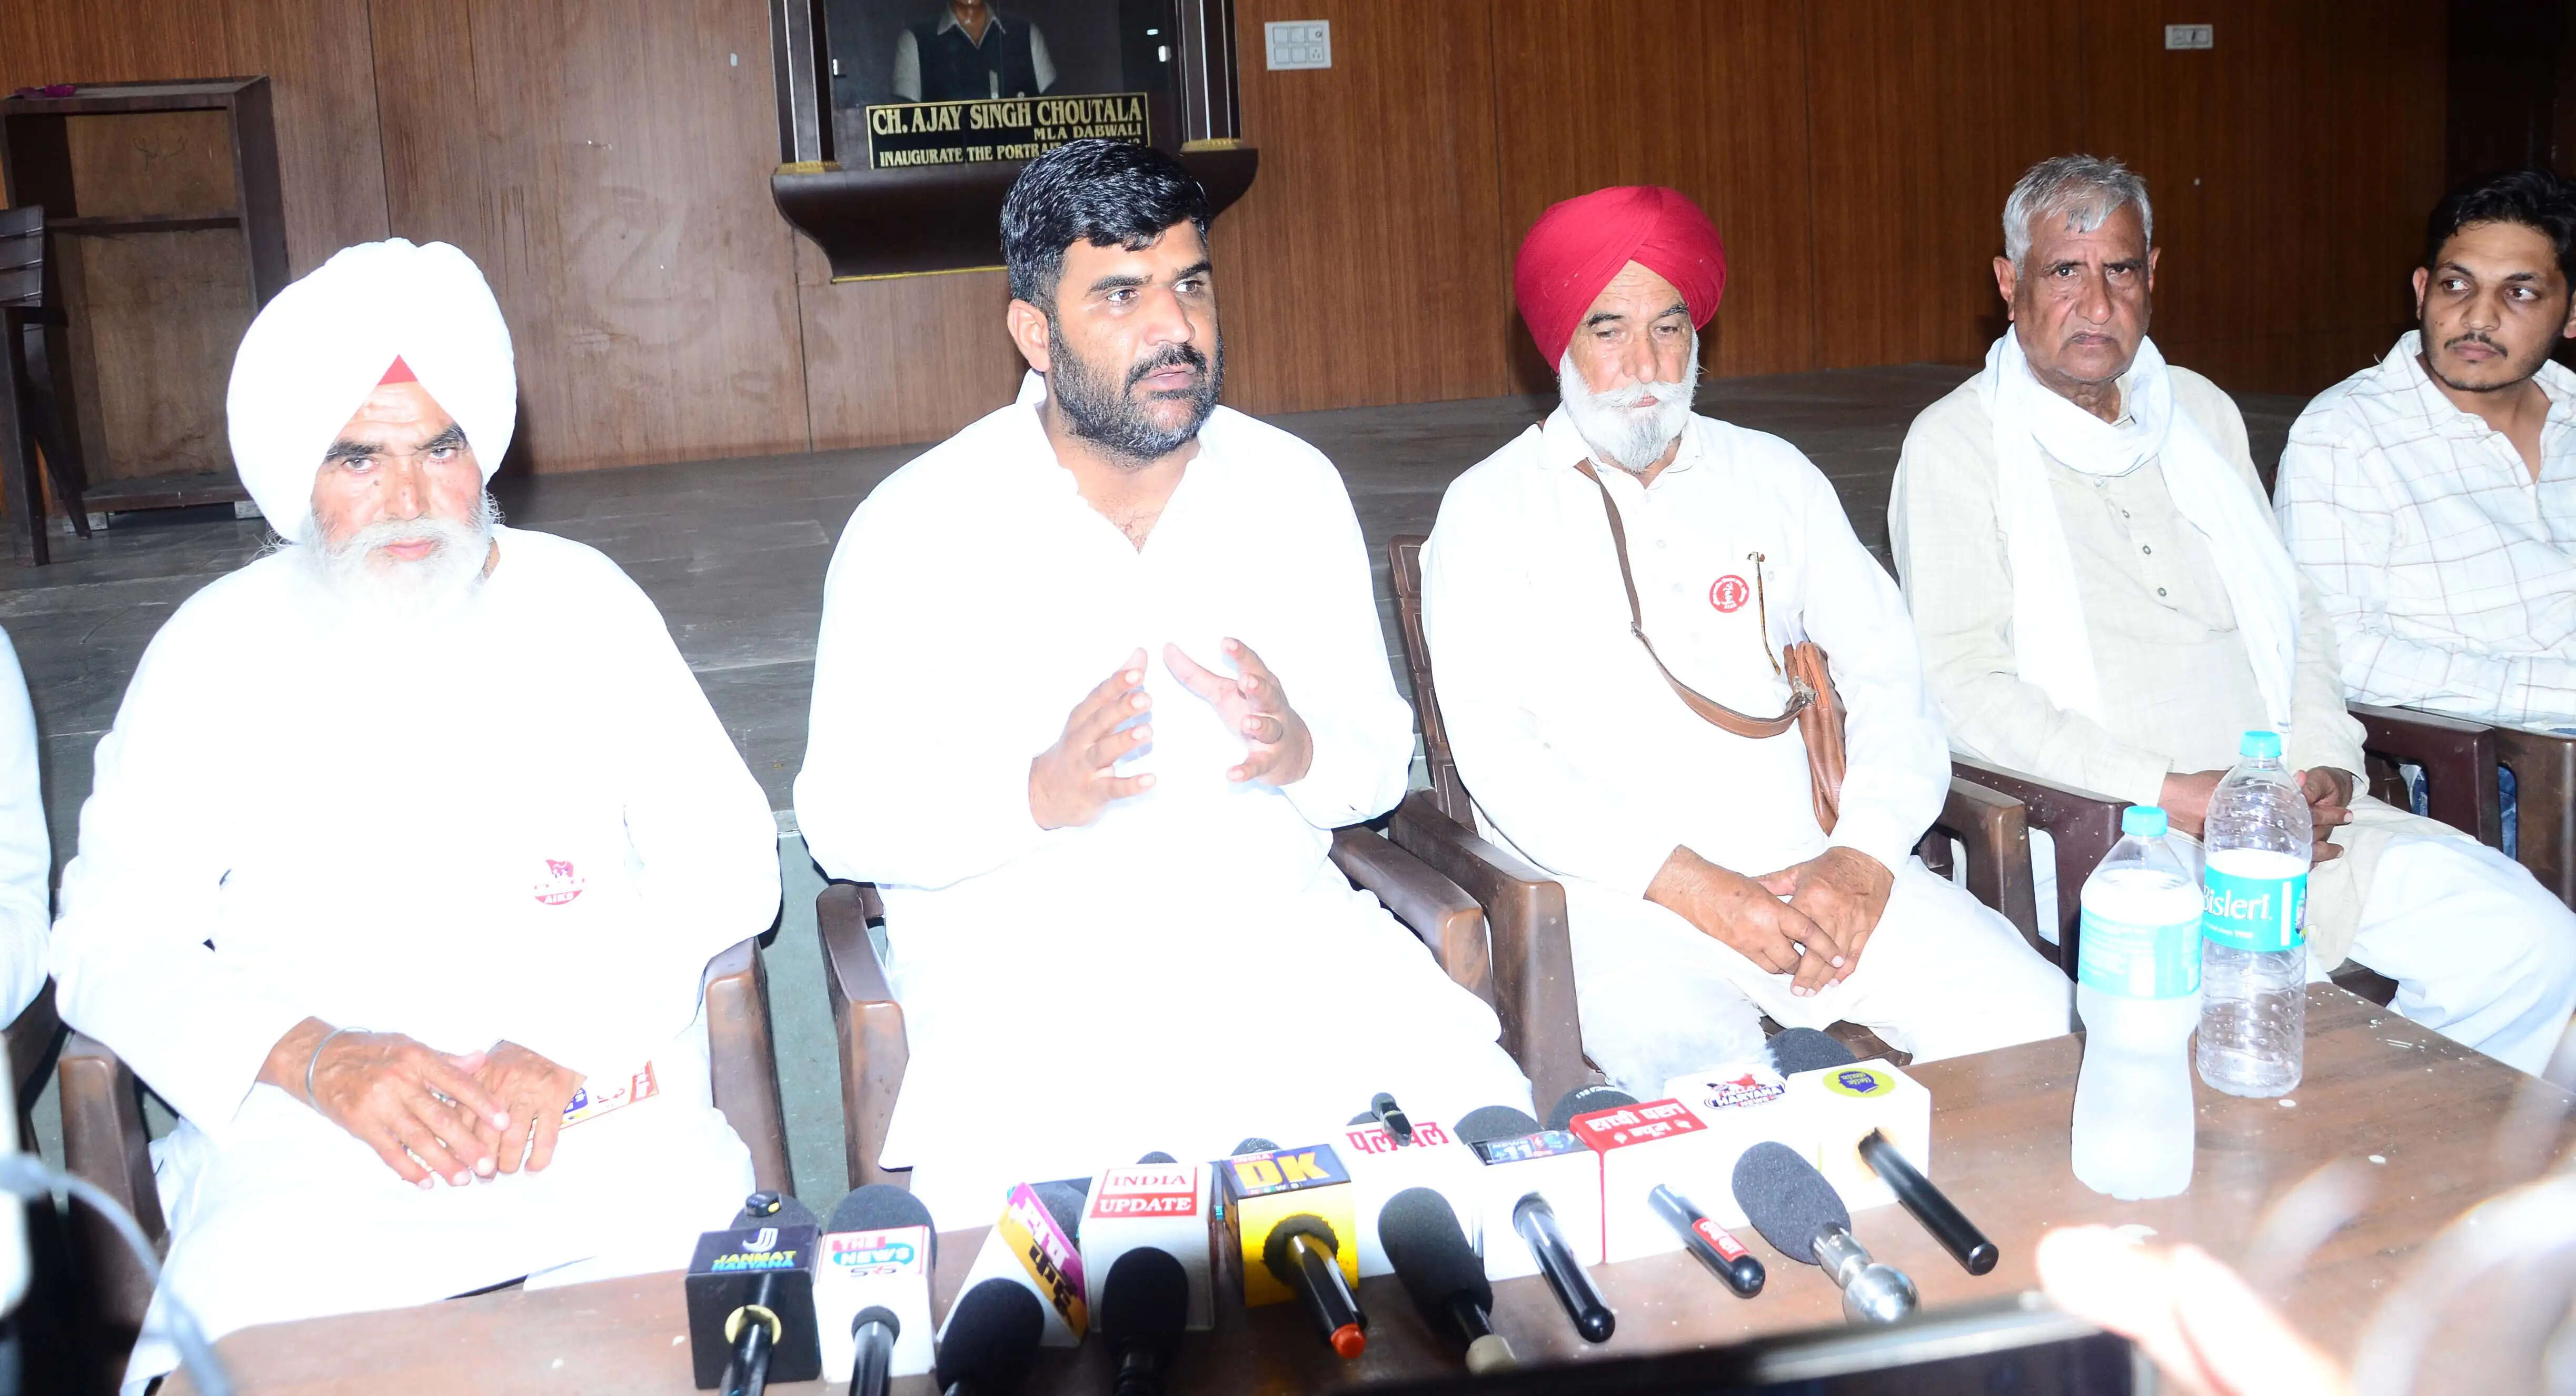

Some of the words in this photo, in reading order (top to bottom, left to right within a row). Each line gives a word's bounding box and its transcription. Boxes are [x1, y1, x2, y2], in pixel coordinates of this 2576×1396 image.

[872, 108, 907, 135] CH.
[911, 105, 963, 133] AJAY
[970, 102, 1032, 130] SINGH
[1037, 97, 1142, 125] CHOUTALA
[1033, 126, 1068, 141] MLA
[1072, 123, 1141, 138] DABWALI
[879, 147, 963, 167] INAUGURATE
[966, 145, 993, 162] THE
[2203, 884, 2270, 921] Bisleri
[1715, 1086, 1782, 1107] HARYANA
[1113, 1175, 1187, 1186] INDIA
[1234, 1152, 1330, 1189] DK
[1099, 1196, 1192, 1212] UPDATE
[841, 1247, 910, 1264] NEWS
